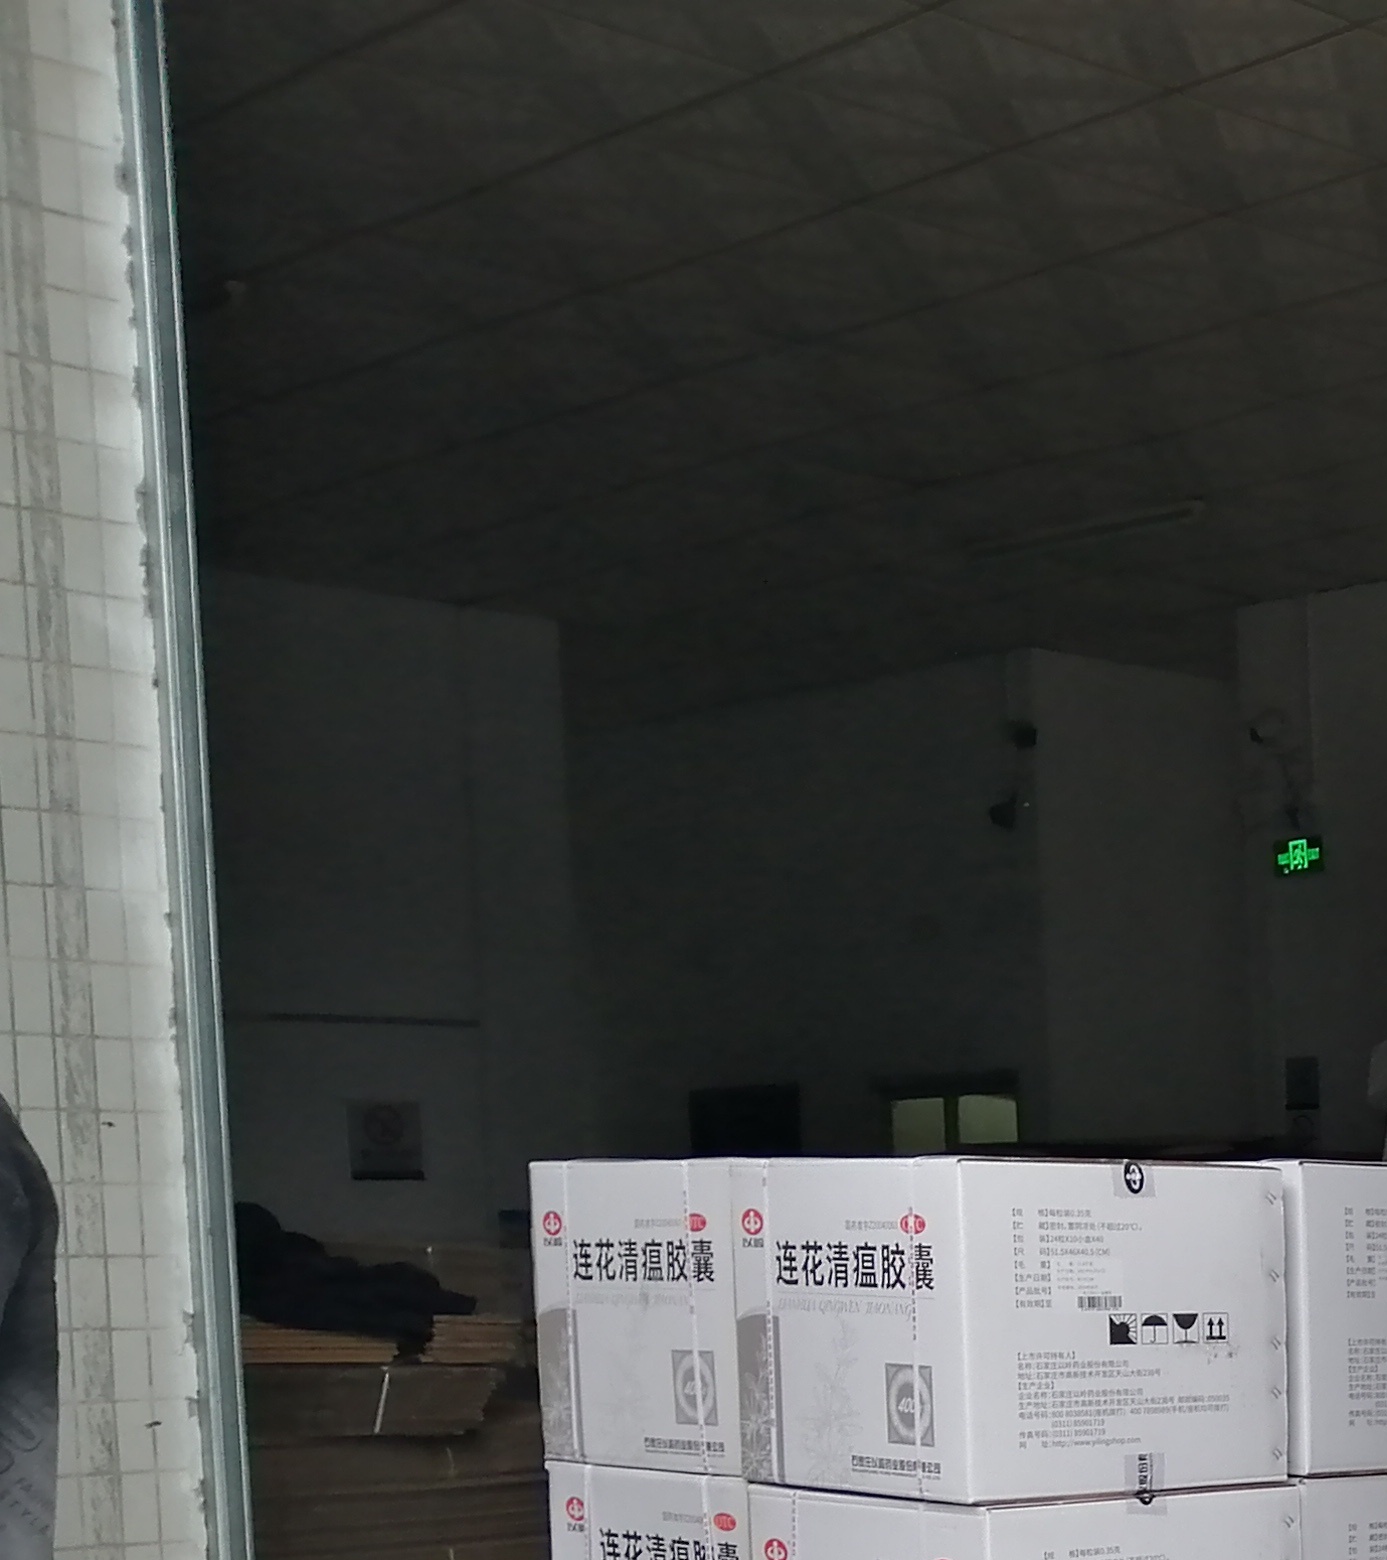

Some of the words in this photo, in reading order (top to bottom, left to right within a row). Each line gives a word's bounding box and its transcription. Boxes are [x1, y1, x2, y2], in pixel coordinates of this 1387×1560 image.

[572, 1238, 715, 1283] 连花清瘟胶囊
[775, 1240, 934, 1290] 连花清瘟胶囊
